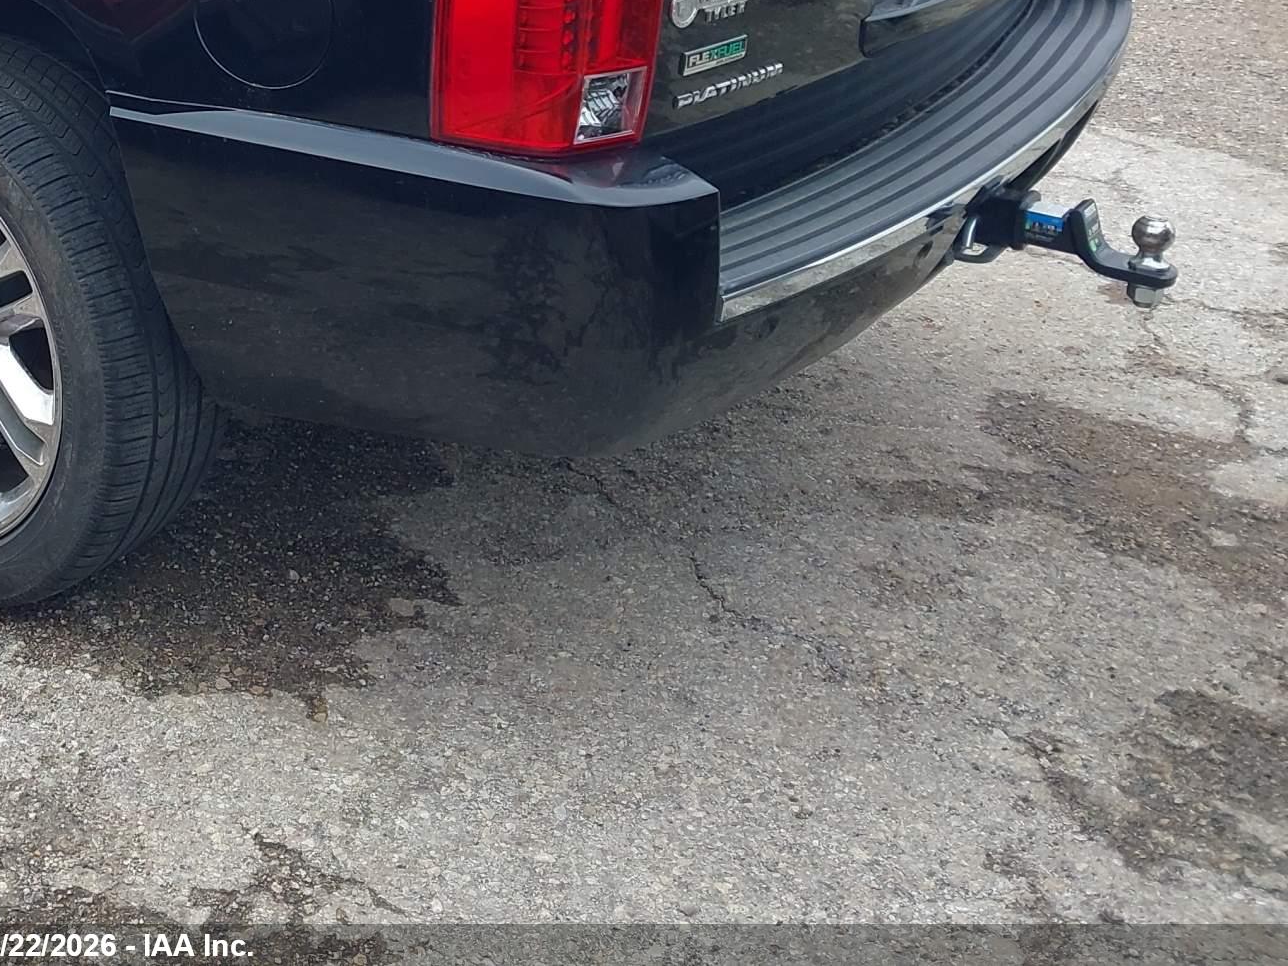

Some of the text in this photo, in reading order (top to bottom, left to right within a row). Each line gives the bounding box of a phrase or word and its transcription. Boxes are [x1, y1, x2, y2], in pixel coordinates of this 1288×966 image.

[704, 0, 747, 22] TYLER
[688, 40, 745, 67] FLEXFUEL
[675, 62, 784, 109] PLATINUM
